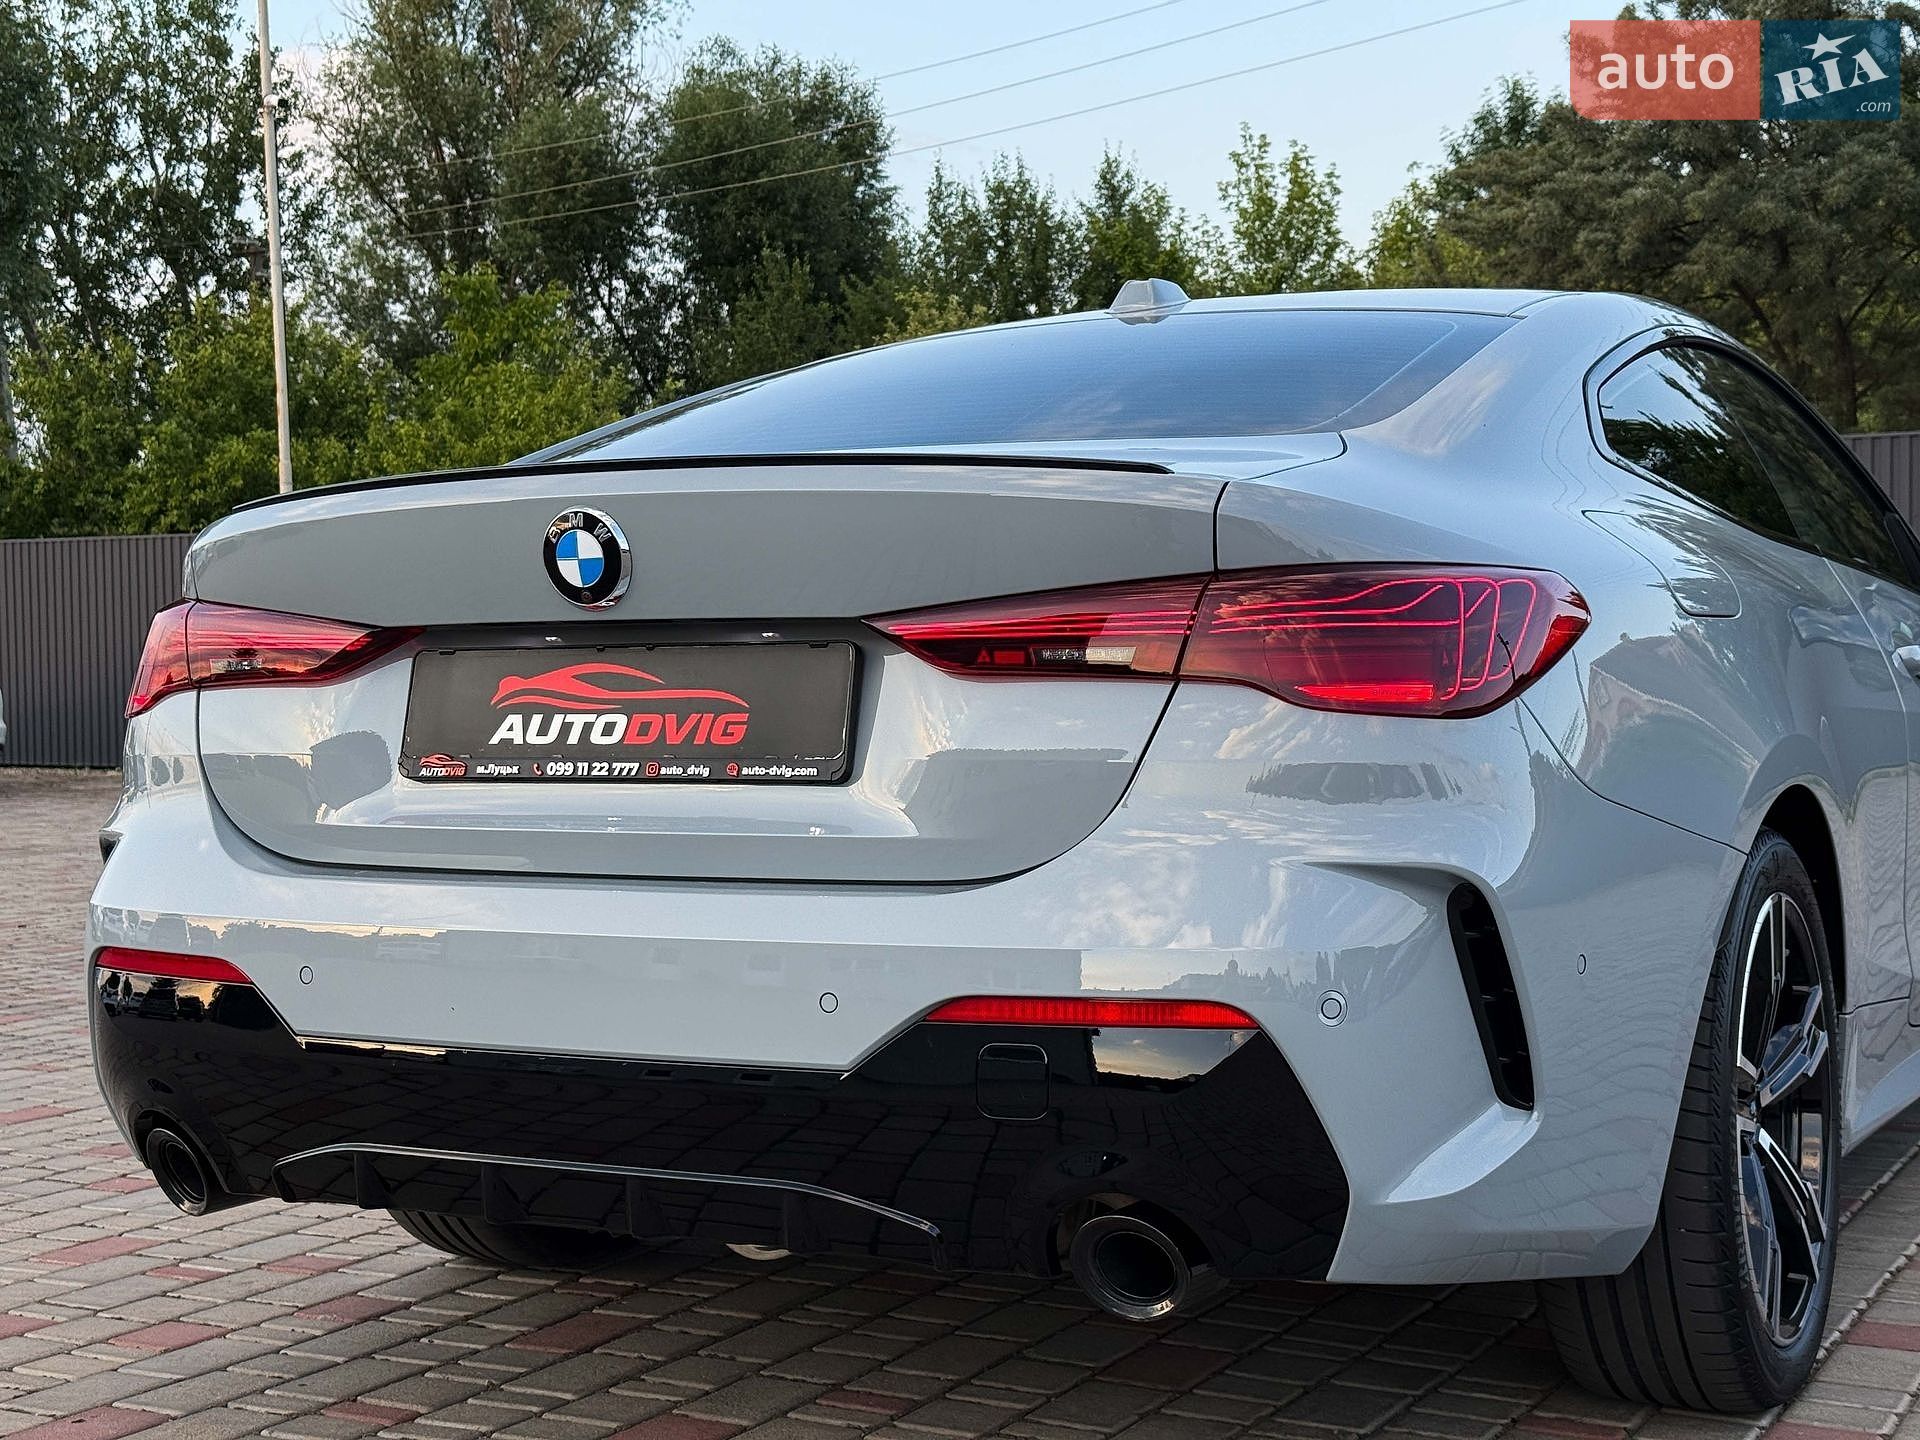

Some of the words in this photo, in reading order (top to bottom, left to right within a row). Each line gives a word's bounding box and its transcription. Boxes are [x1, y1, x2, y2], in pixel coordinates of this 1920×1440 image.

[548, 512, 612, 544] BMW
[488, 712, 751, 746] AUTODVIG
[546, 761, 575, 776] 099
[576, 761, 590, 776] 11
[591, 761, 610, 776] 22
[611, 762, 640, 776] 777
[659, 764, 711, 777] auto_dvig
[741, 764, 819, 777] auto-dvig.com
